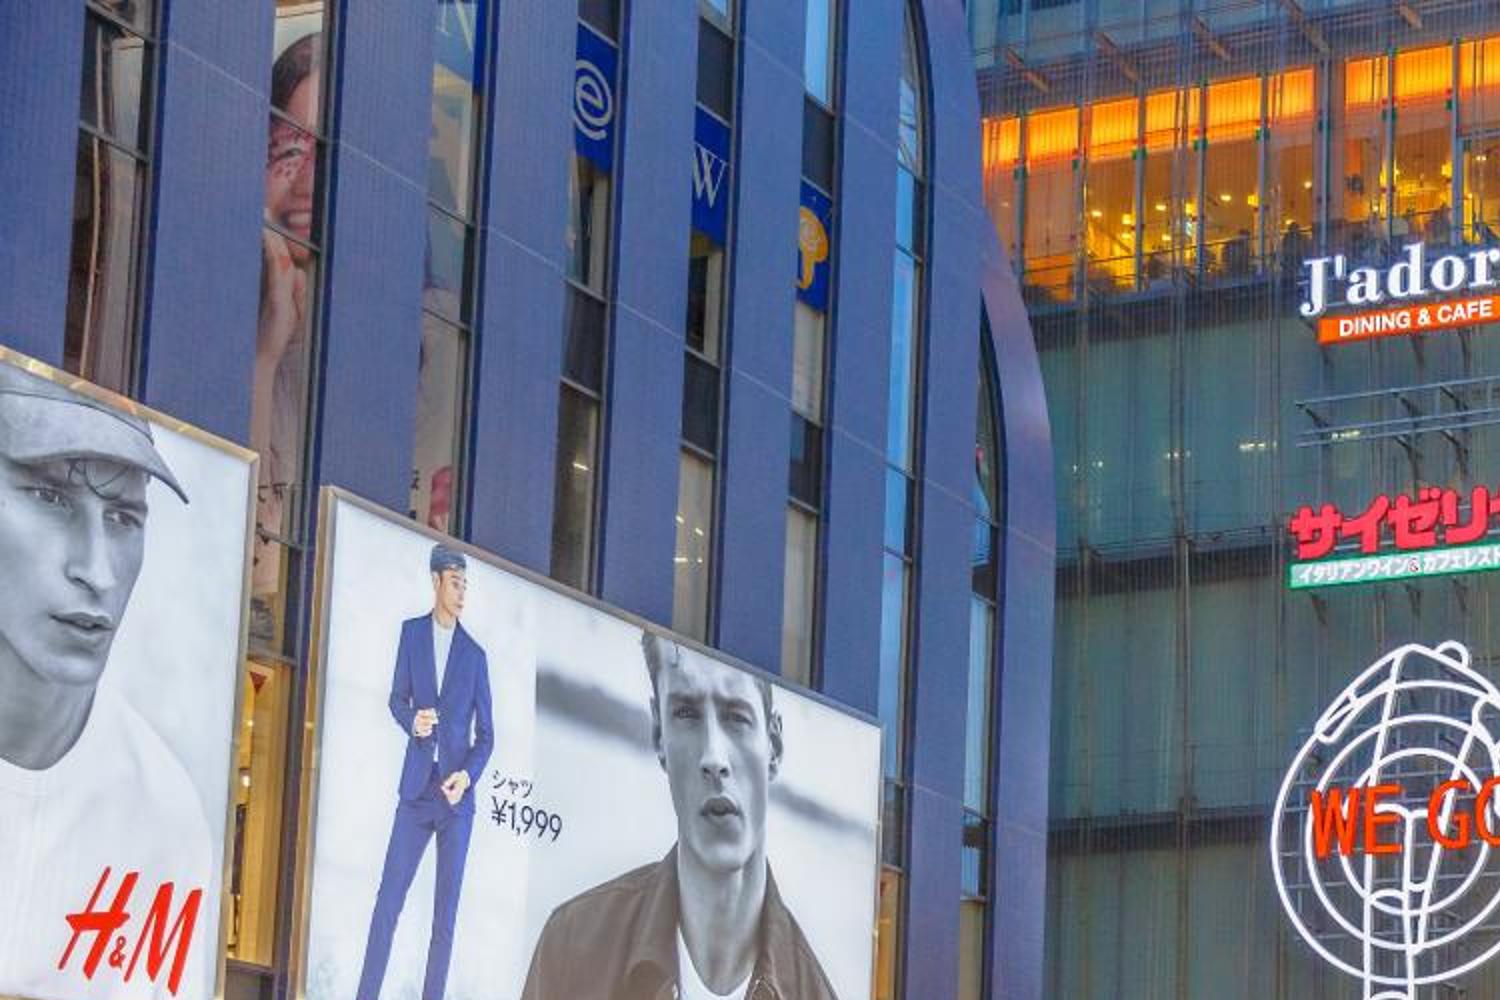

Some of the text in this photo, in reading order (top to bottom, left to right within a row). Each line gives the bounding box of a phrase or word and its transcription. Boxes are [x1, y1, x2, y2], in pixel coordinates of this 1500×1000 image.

[1338, 299, 1494, 337] DINING & CAFE
[492, 769, 533, 799] シャツ
[491, 795, 562, 842] ¥1,999
[1311, 784, 1406, 858] WE
[57, 865, 203, 999] H&M
